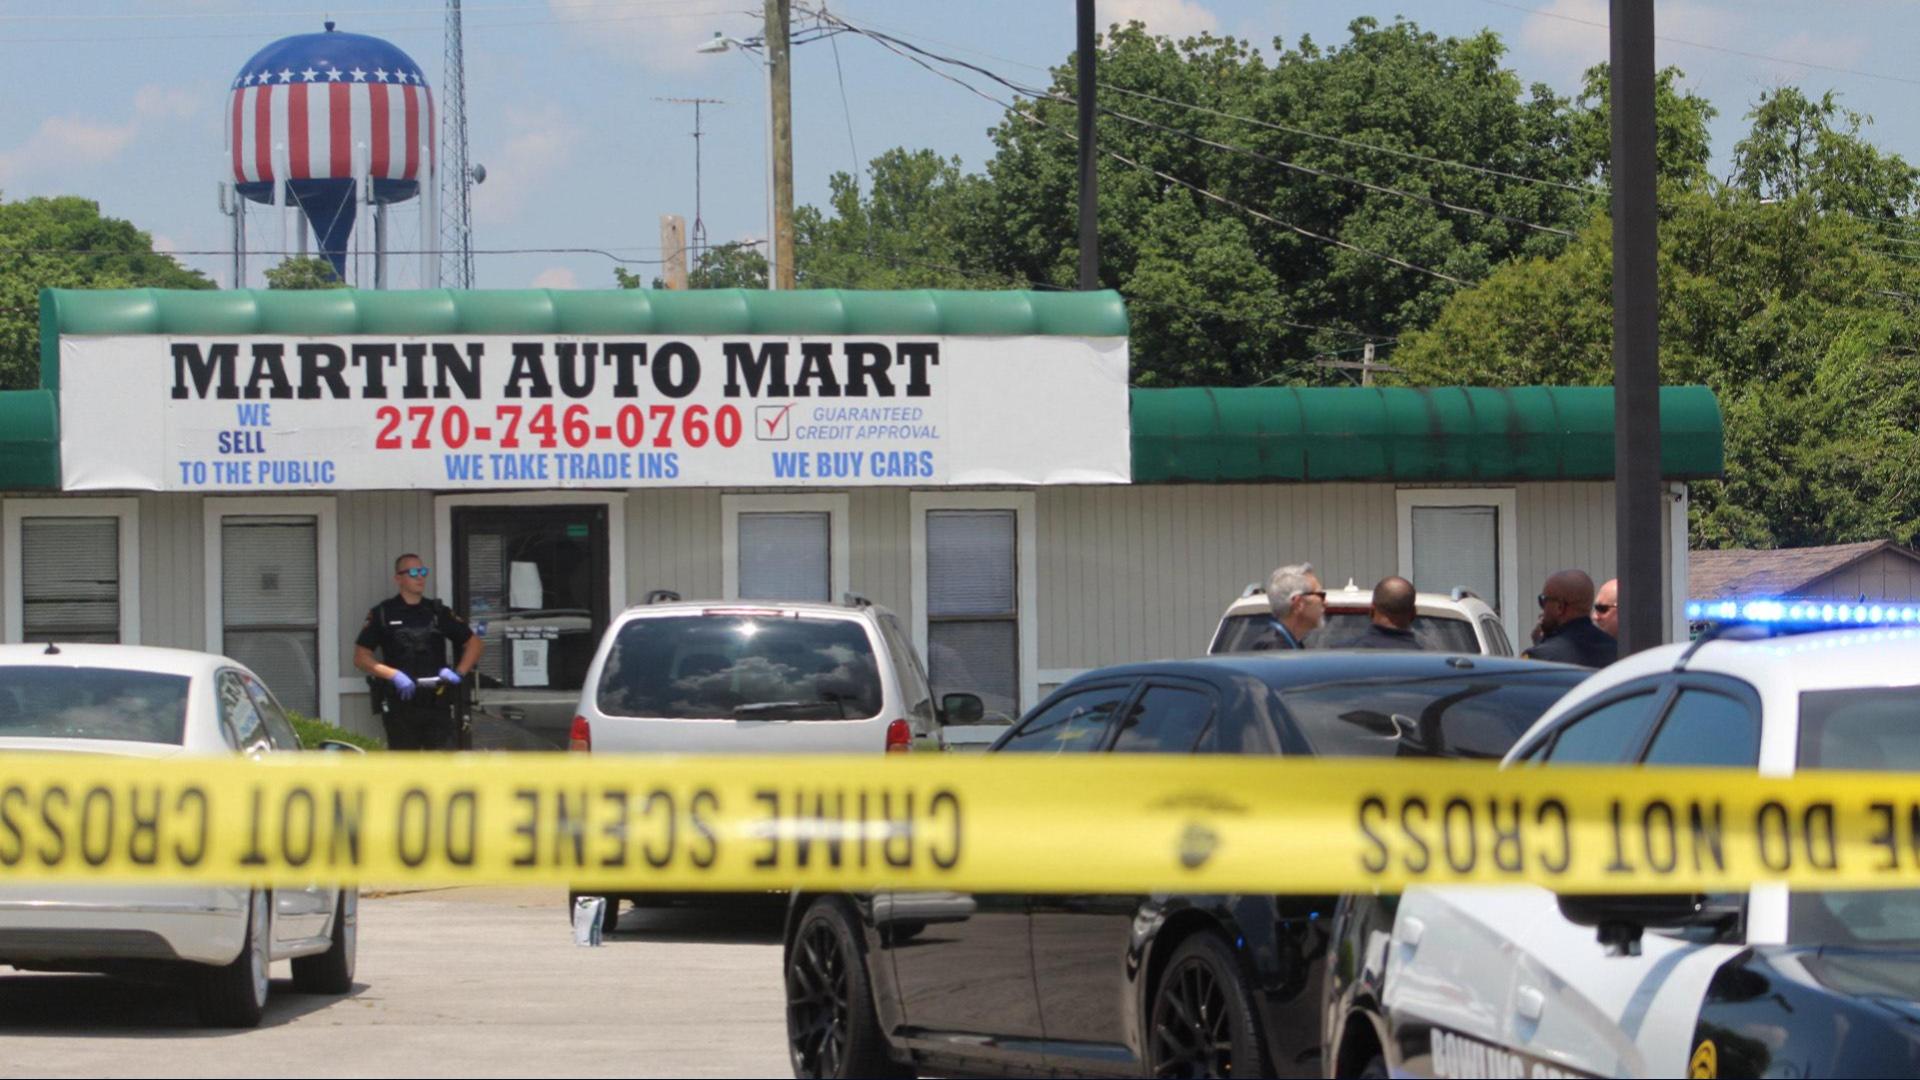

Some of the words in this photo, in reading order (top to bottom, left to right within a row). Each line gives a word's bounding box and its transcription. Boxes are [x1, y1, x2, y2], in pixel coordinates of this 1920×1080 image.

[171, 343, 484, 400] MARTIN
[504, 342, 701, 399] AUTO
[723, 342, 939, 397] MART
[218, 431, 265, 454] SELL
[237, 403, 271, 427] WE
[375, 404, 742, 449] 270-746-0760
[795, 426, 853, 440] CREDIT
[856, 425, 940, 439] APPROVAL
[813, 407, 923, 421] GUARANTEED
[179, 461, 207, 484] TO
[212, 461, 252, 484] THE
[258, 460, 335, 484] PUBLIC
[445, 455, 483, 480] WE
[490, 454, 548, 480] TAKE
[554, 453, 631, 479] TRADE
[639, 453, 679, 479] INS
[772, 452, 810, 478] WE
[817, 452, 863, 477] BUY
[870, 450, 933, 477] CARS
[0, 786, 209, 867] CROSS
[240, 787, 363, 867] NOT
[397, 787, 478, 868] DO
[512, 788, 721, 869] SCENE
[752, 790, 962, 870] CRIME
[1359, 796, 1571, 874] CROSS
[1606, 799, 1726, 874] NOT
[1757, 801, 1838, 872] DO
